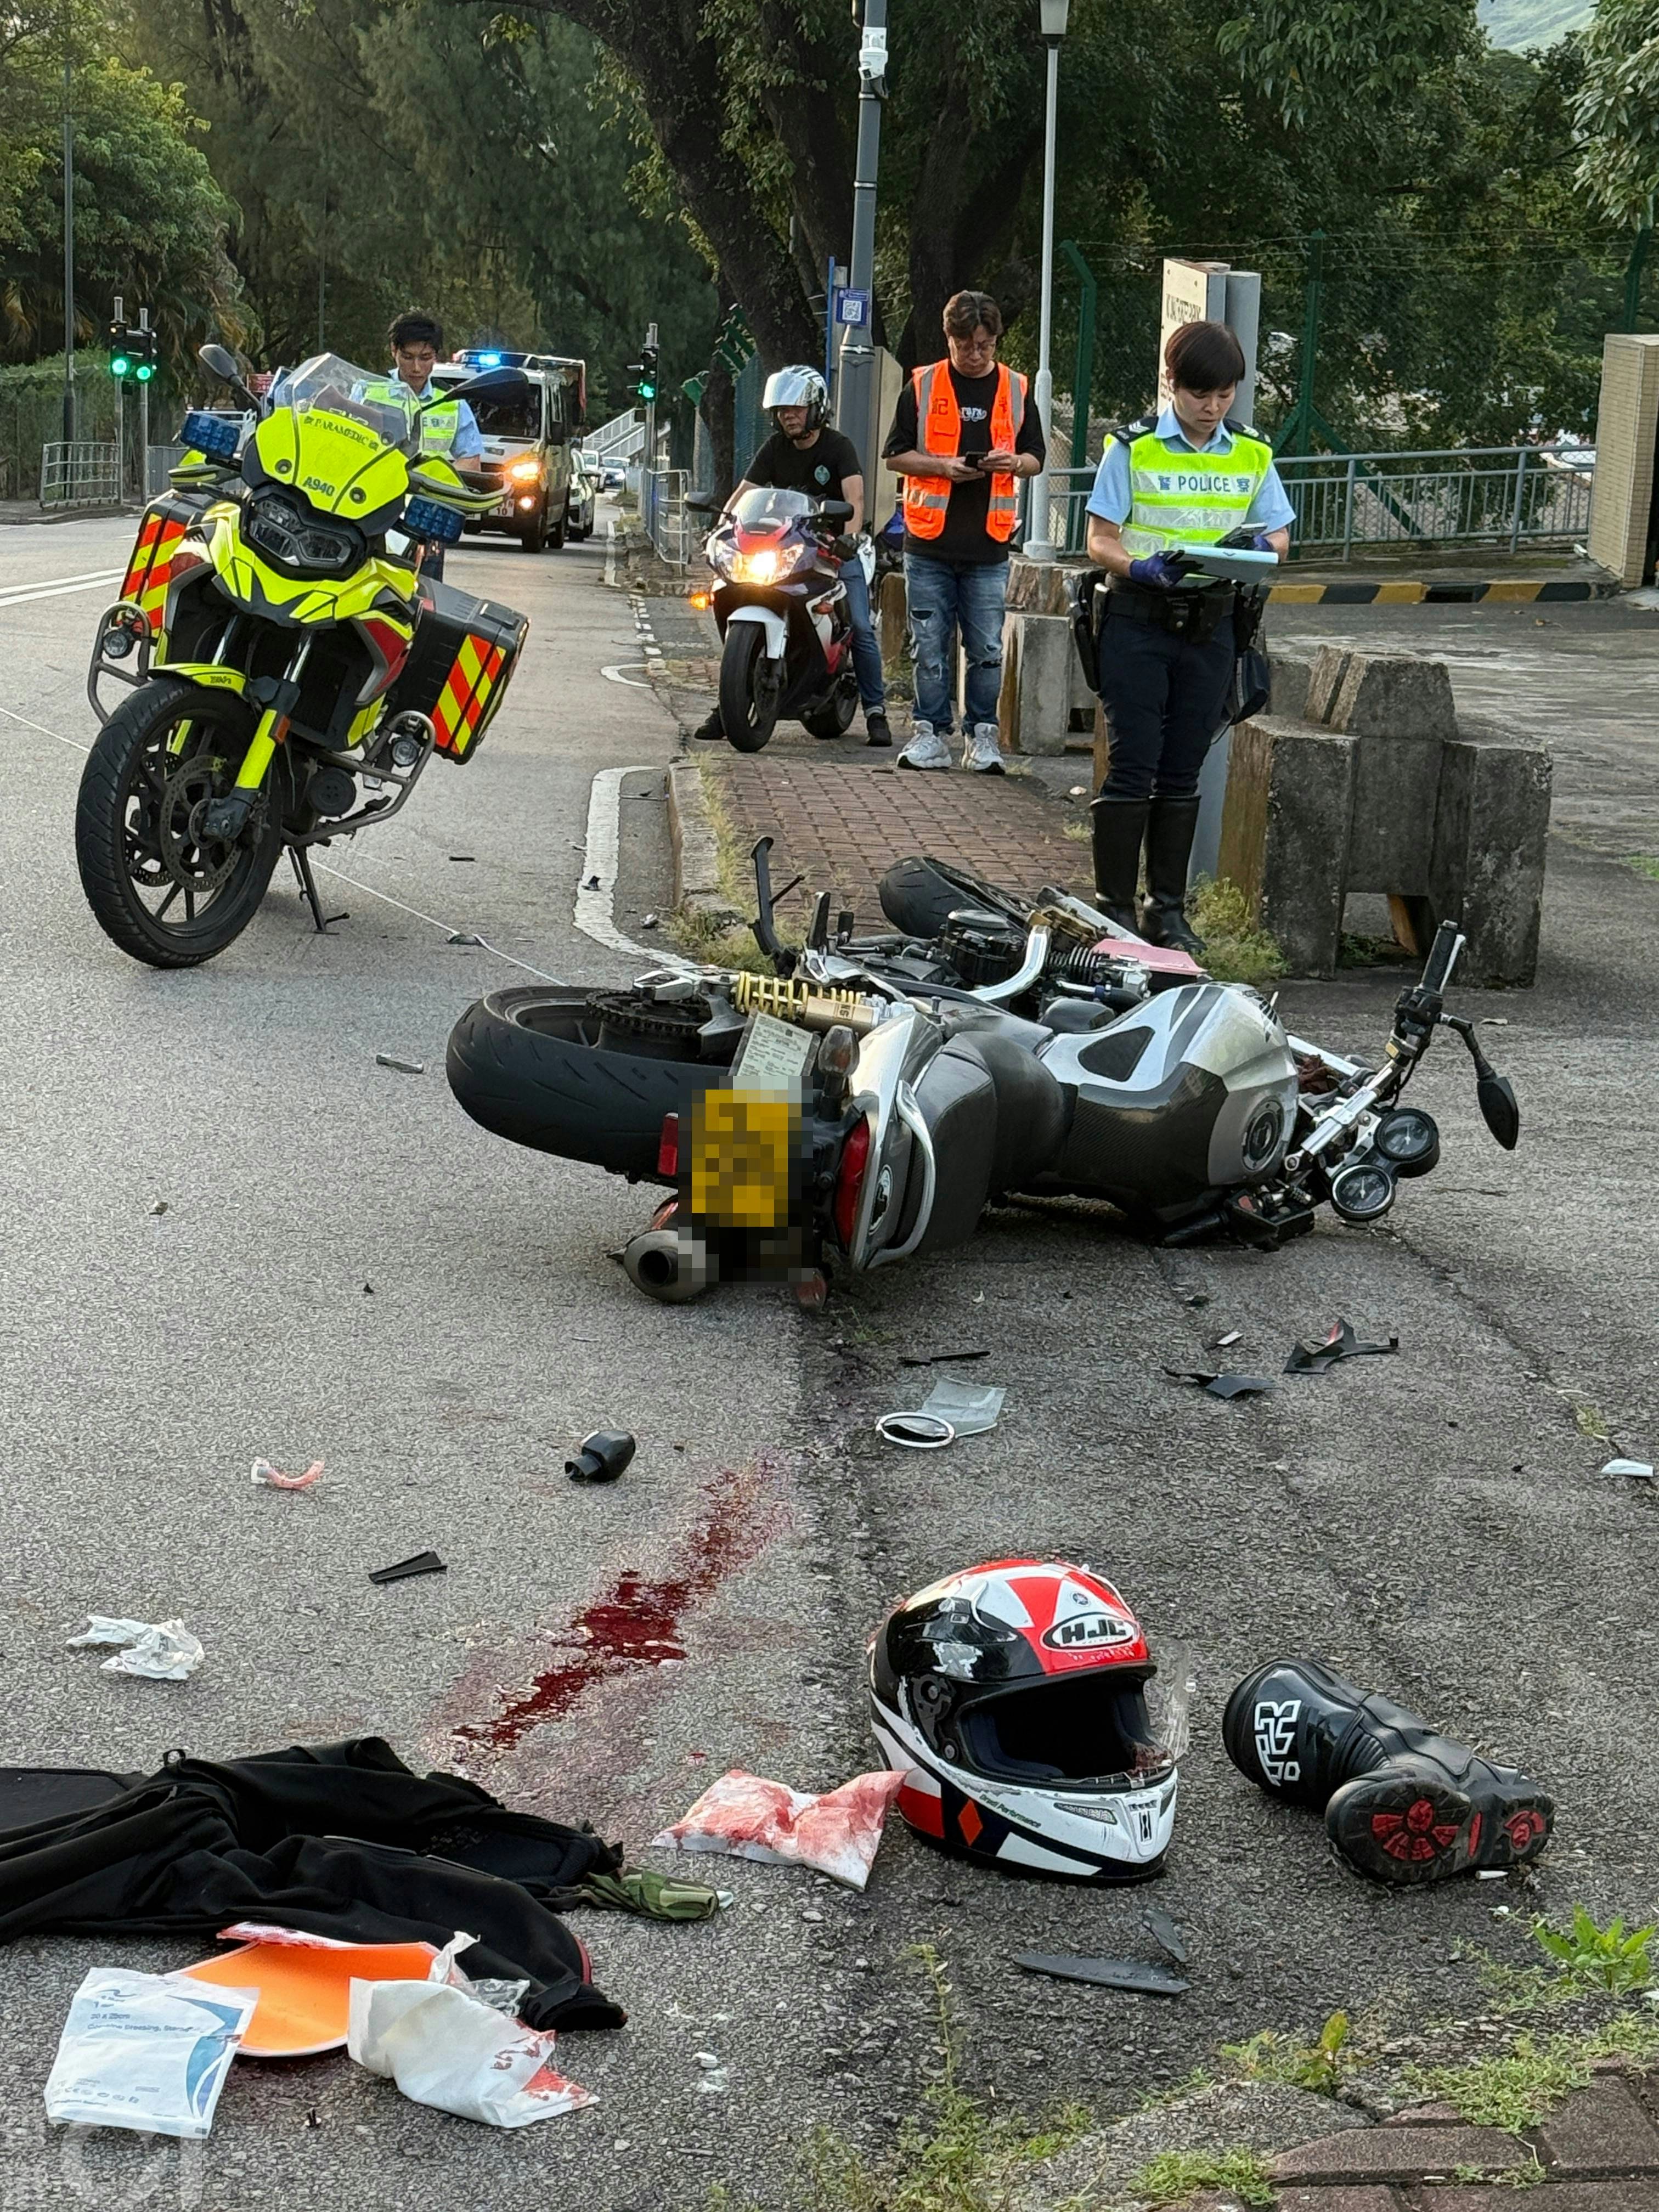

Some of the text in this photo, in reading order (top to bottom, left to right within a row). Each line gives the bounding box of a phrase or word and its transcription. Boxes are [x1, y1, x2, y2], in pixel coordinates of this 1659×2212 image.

[314, 419, 369, 445] PARAMEDIC
[302, 476, 335, 496] A940
[1178, 476, 1231, 493] POLICE
[1061, 1619, 1127, 1644] HJC
